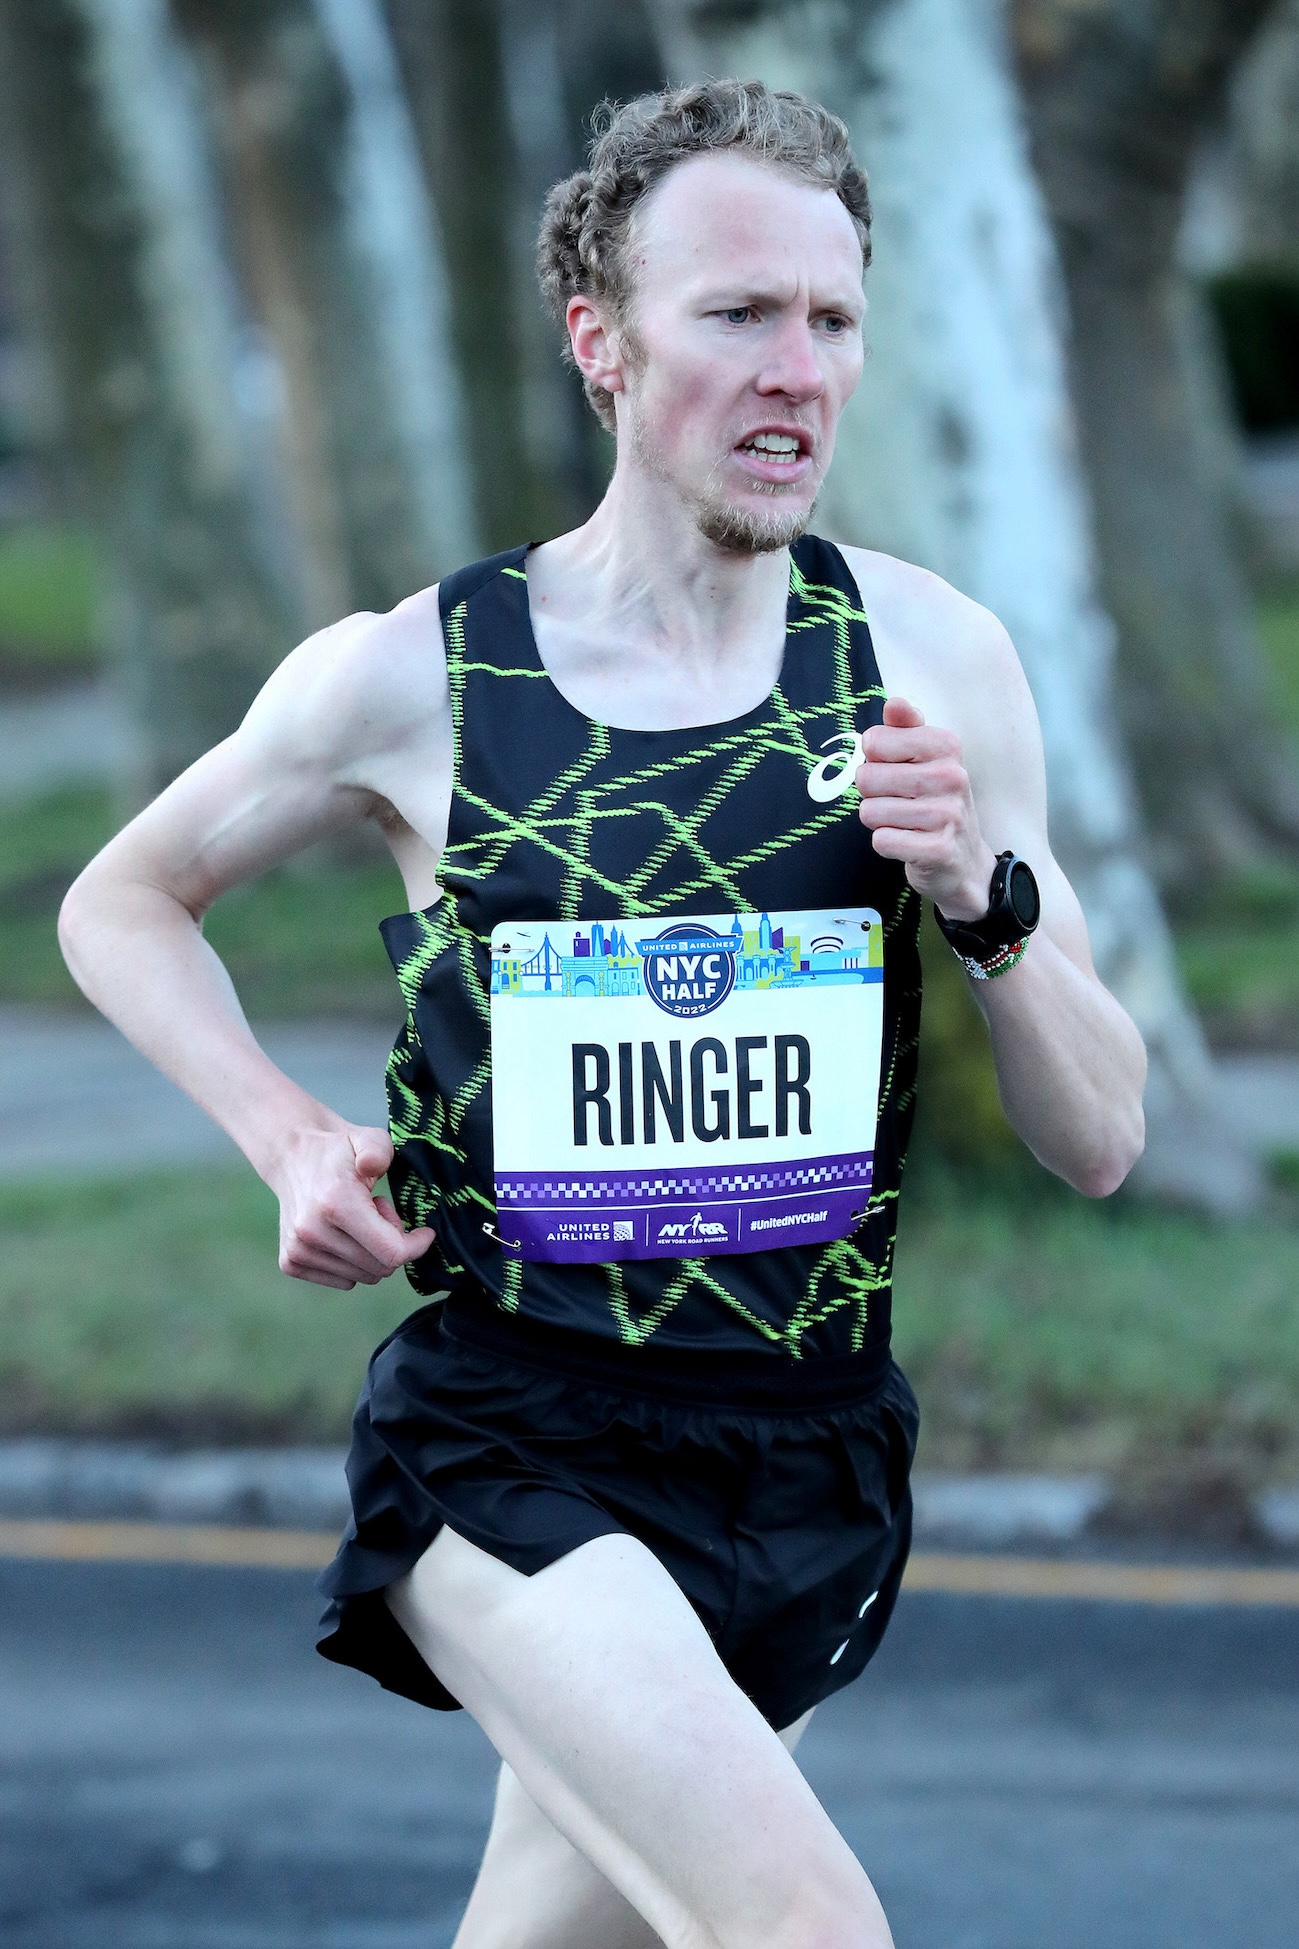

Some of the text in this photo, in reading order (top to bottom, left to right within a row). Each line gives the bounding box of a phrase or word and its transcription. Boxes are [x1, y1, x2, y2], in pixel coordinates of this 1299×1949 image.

[642, 941, 734, 951] UNITED AIRLINES
[656, 954, 721, 981] NYC
[661, 982, 716, 1000] HALF
[673, 1004, 707, 1014] 2022
[572, 1034, 812, 1146] RINGER
[559, 1223, 610, 1232] UNITED
[750, 1210, 828, 1231] #UnitedNYCHalf
[546, 1232, 610, 1241] AIRLINES
